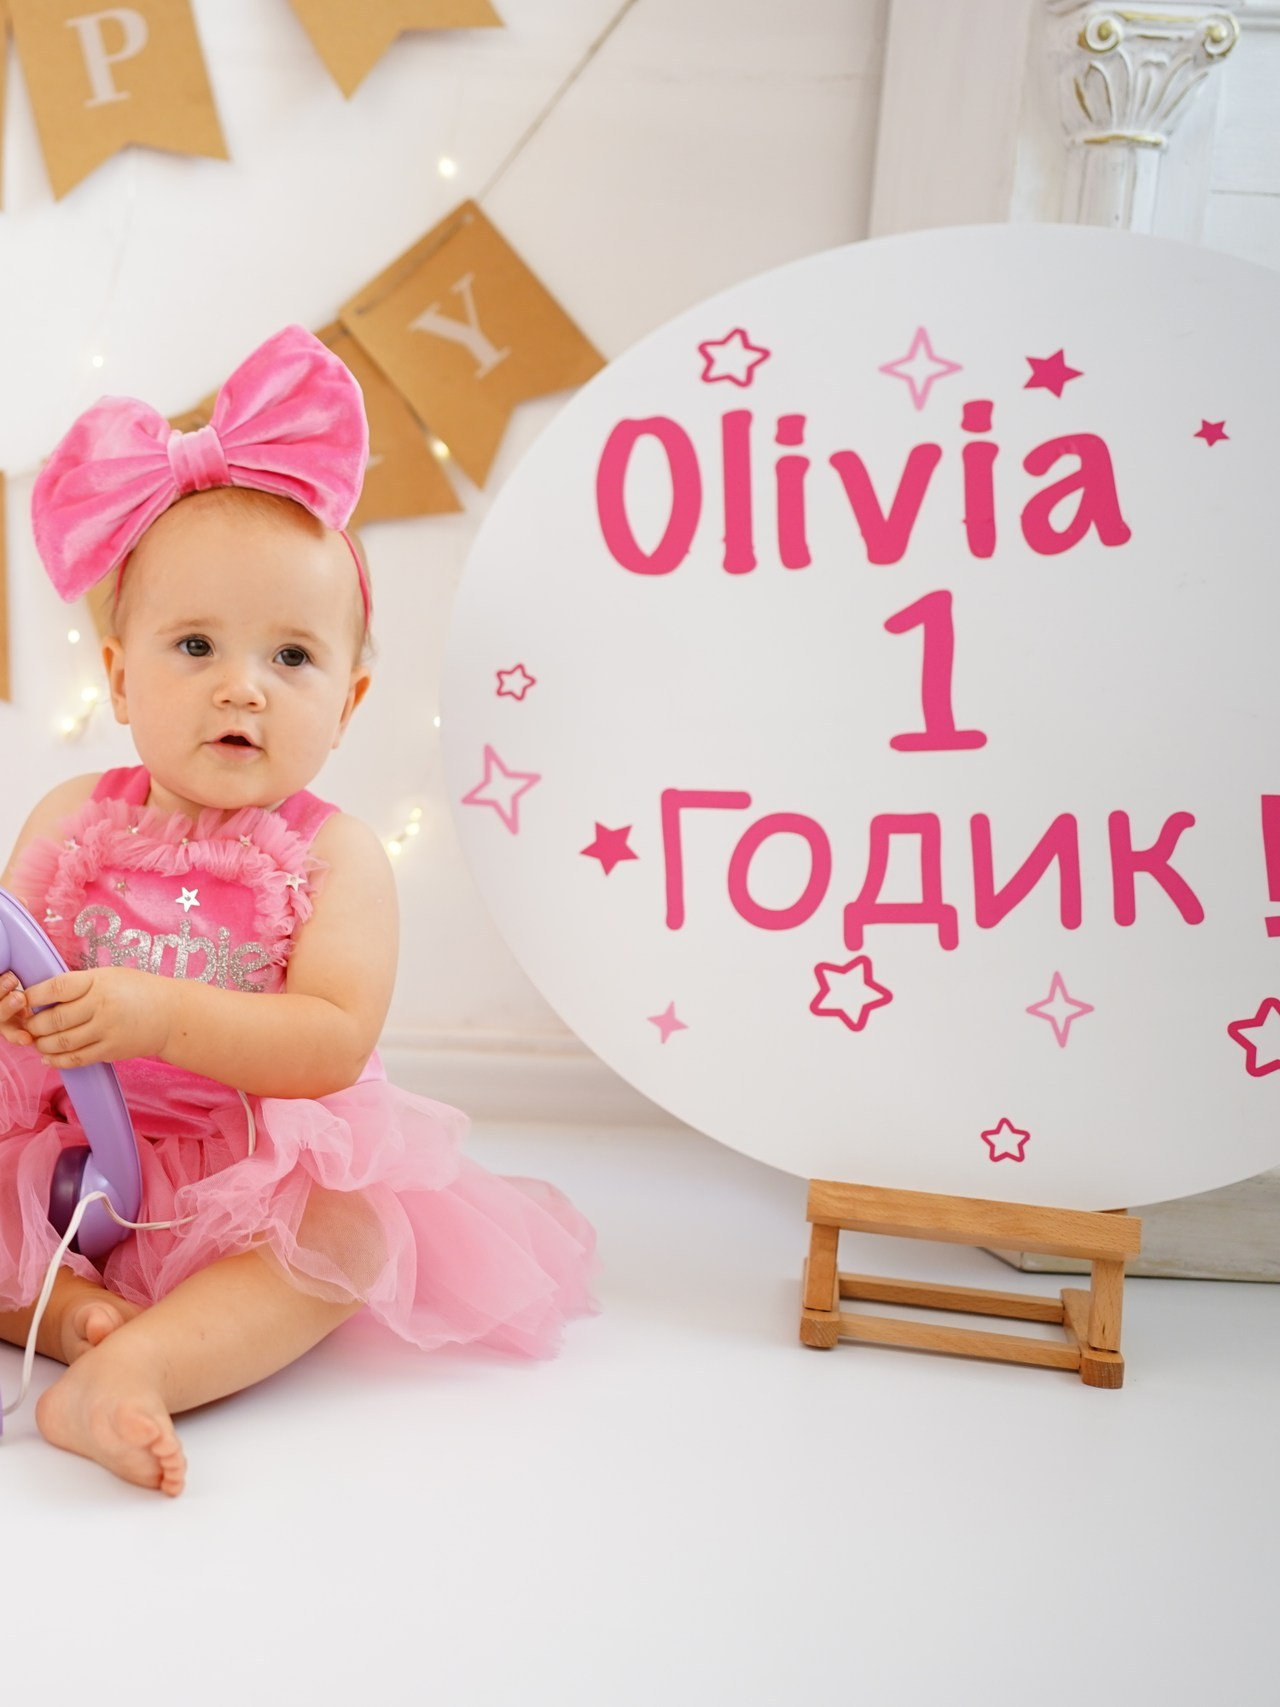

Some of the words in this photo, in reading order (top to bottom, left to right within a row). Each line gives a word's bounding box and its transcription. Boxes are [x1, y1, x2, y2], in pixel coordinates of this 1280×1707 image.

[595, 399, 1132, 576] Olivia
[883, 589, 988, 752] 1
[73, 904, 271, 992] Barbie
[660, 788, 1205, 951] Годик
